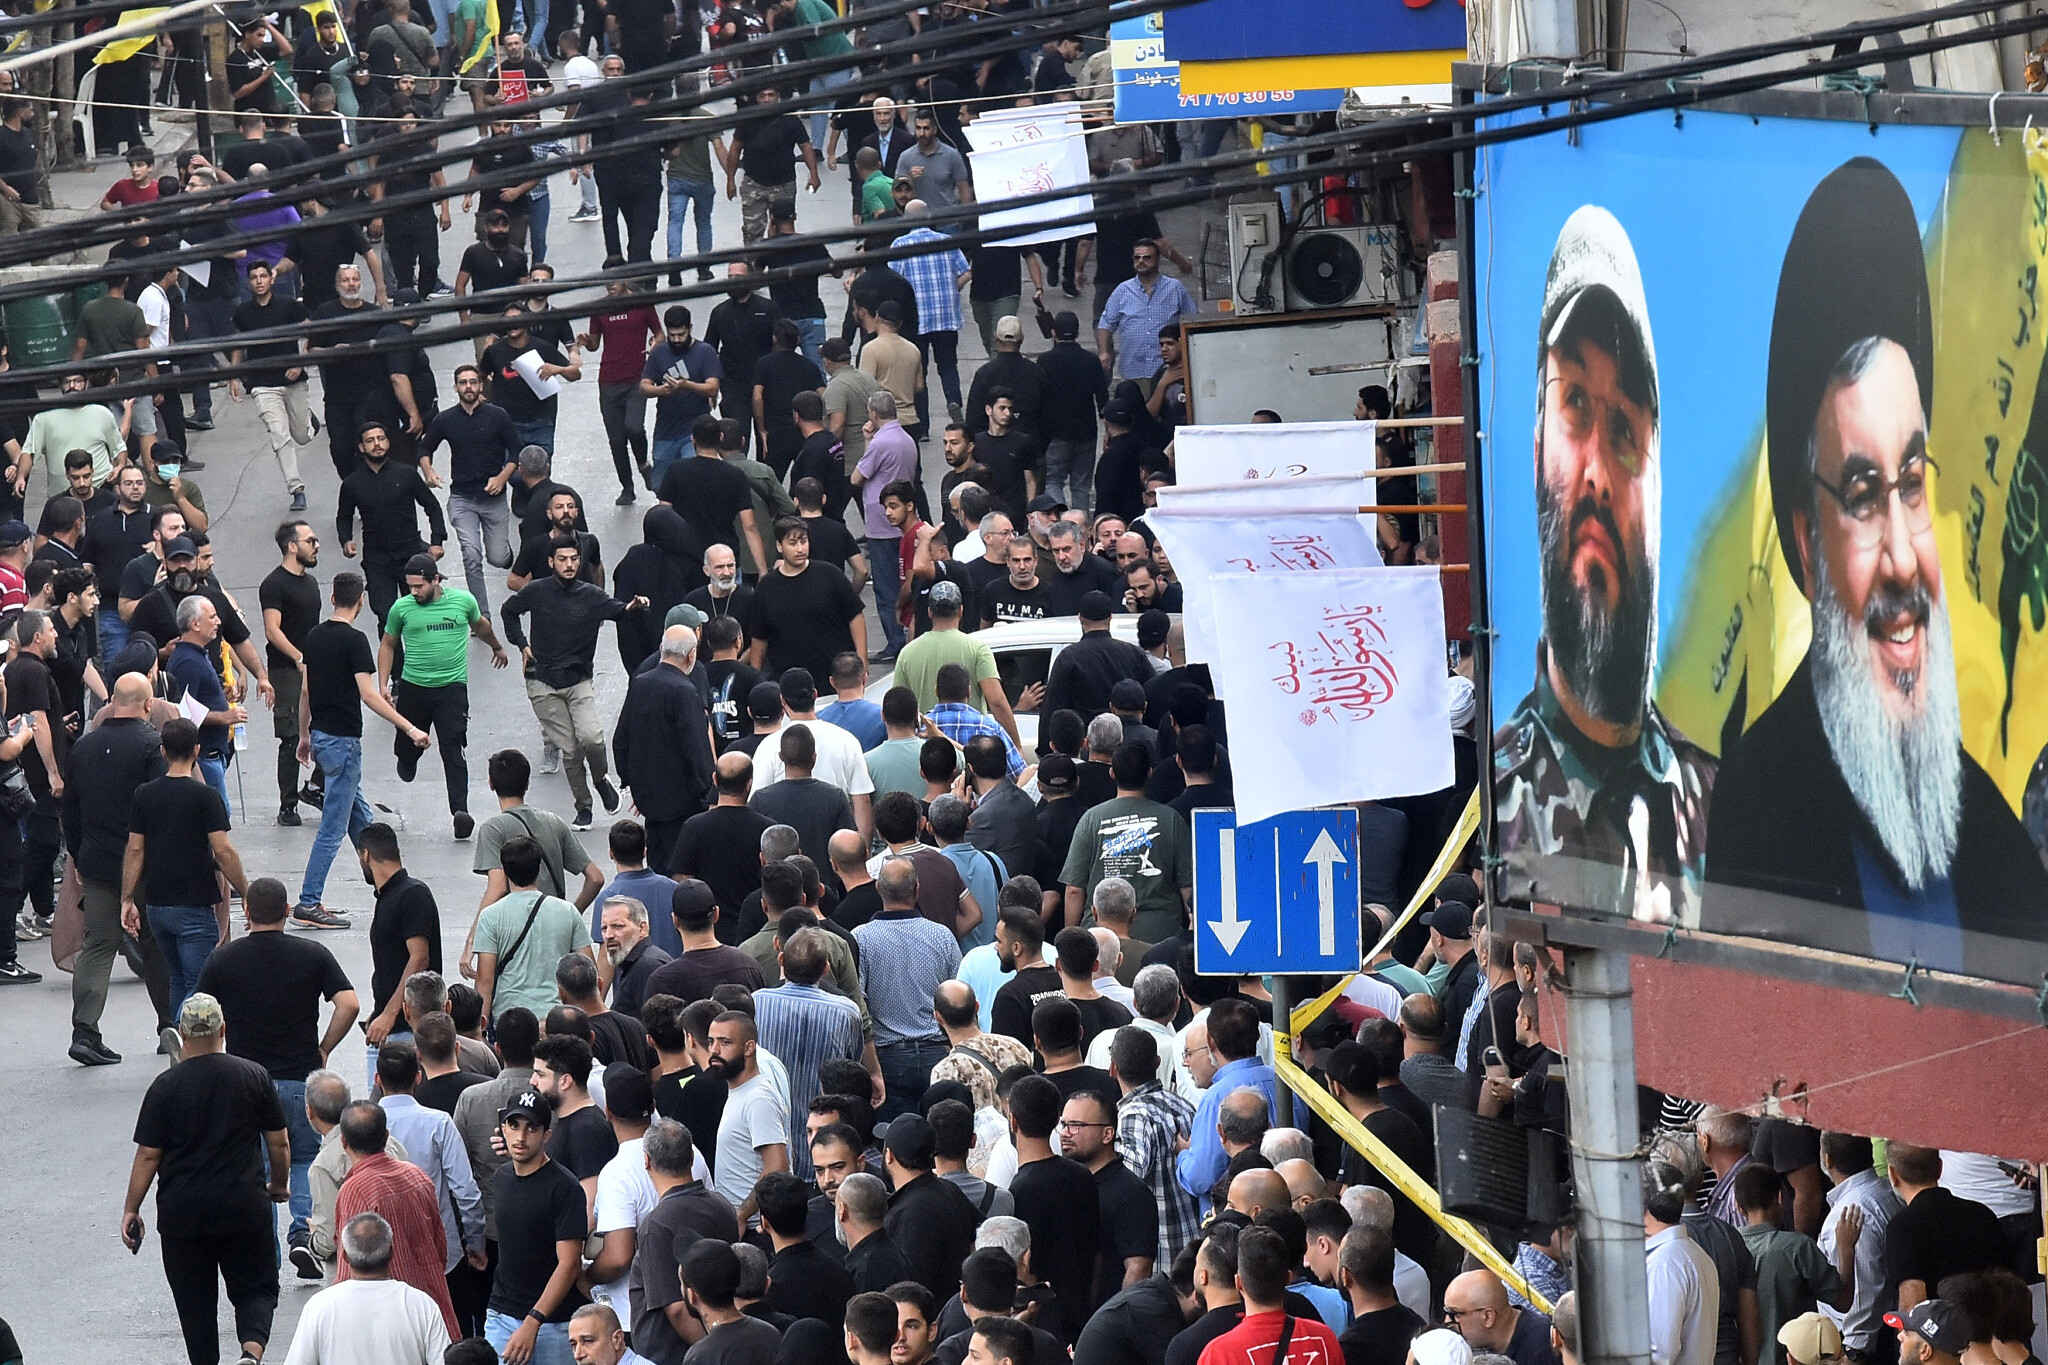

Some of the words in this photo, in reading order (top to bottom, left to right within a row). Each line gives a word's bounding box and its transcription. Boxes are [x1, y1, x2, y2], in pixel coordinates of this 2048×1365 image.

[1987, 357, 2014, 420] الله
[996, 602, 1044, 616] PUMA
[426, 622, 454, 632] PUMA
[1267, 640, 1305, 694] لبيك
[518, 1091, 536, 1107] NY
